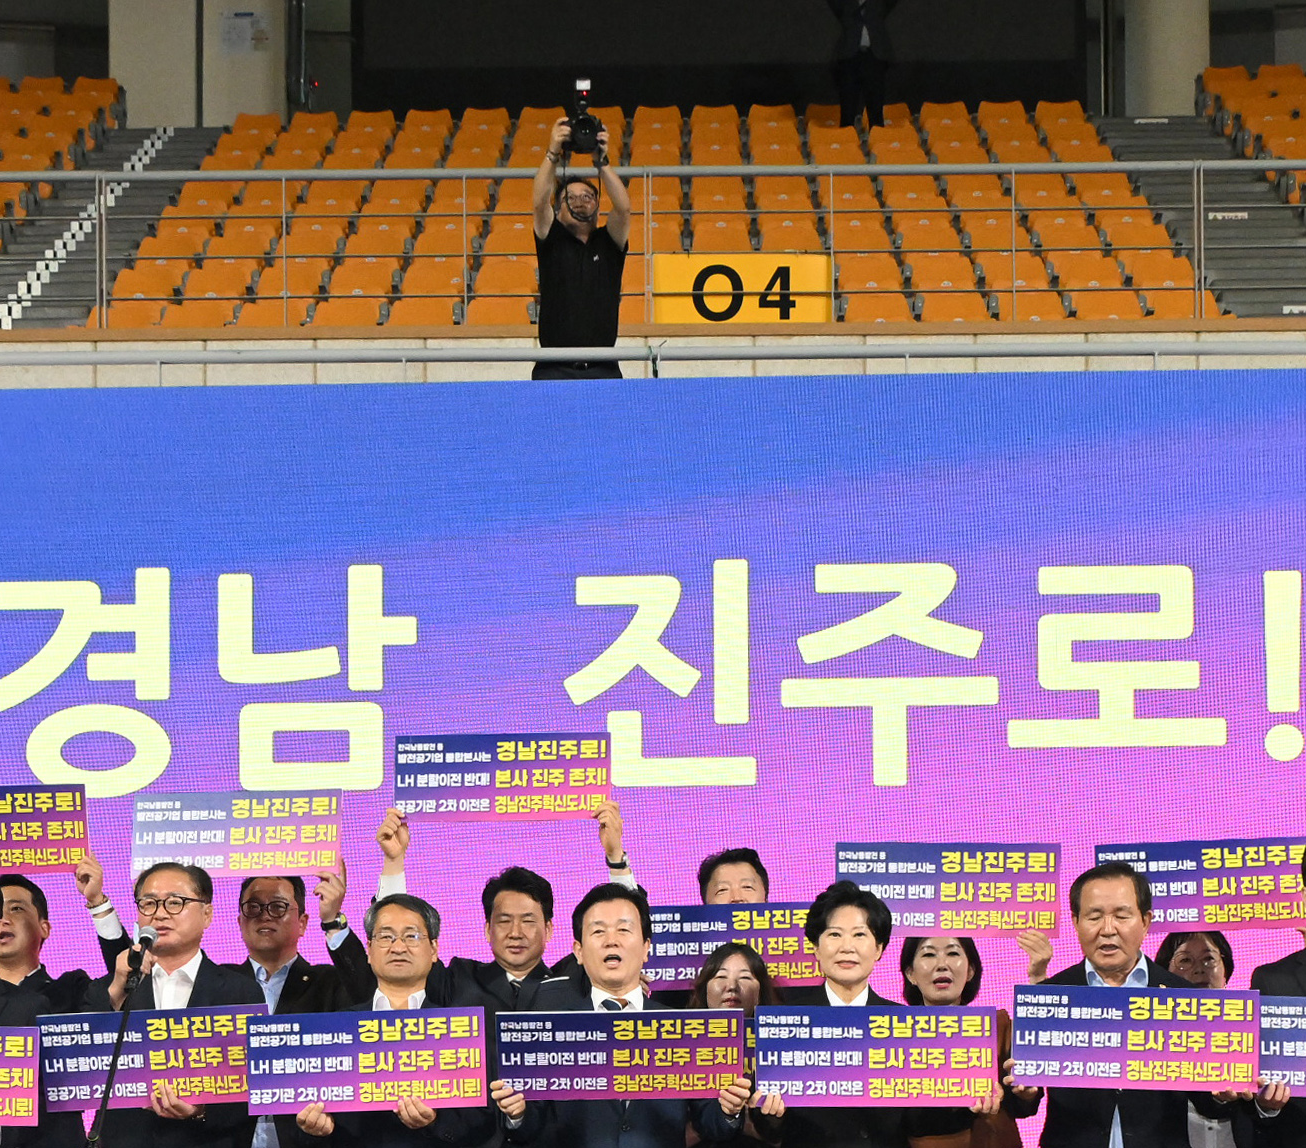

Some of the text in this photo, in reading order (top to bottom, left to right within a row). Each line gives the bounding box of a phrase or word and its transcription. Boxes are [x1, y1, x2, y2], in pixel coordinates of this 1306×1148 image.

[564, 558, 1304, 788] 진주로!
[495, 738, 607, 762] 경남진주로!
[494, 766, 607, 788] 본사 진주 존치!
[231, 795, 337, 819] 경남진주로!
[228, 823, 337, 845] 본사 진주 존치!
[940, 850, 1055, 873] 경남진주로!
[939, 881, 1056, 903] 본사 진주 존치!
[1015, 995, 1253, 1021] 발전공기업 통합본사는 경남진주로!
[357, 1014, 479, 1043] 경남진주로!
[612, 1017, 738, 1040] 경남진주로!
[868, 1014, 991, 1038] 경남진주로!
[1014, 1028, 1254, 1054] LH 분할이전 반대! 본사 진주 존치!
[357, 1046, 481, 1074] 본사 진주 존치!
[611, 1045, 739, 1067] 본사 진주 존치!
[867, 1046, 993, 1069] 본사 진주 존치!
[1011, 1058, 1253, 1083] 공공기관 2차 이전은 경남진주혁신도시로!
